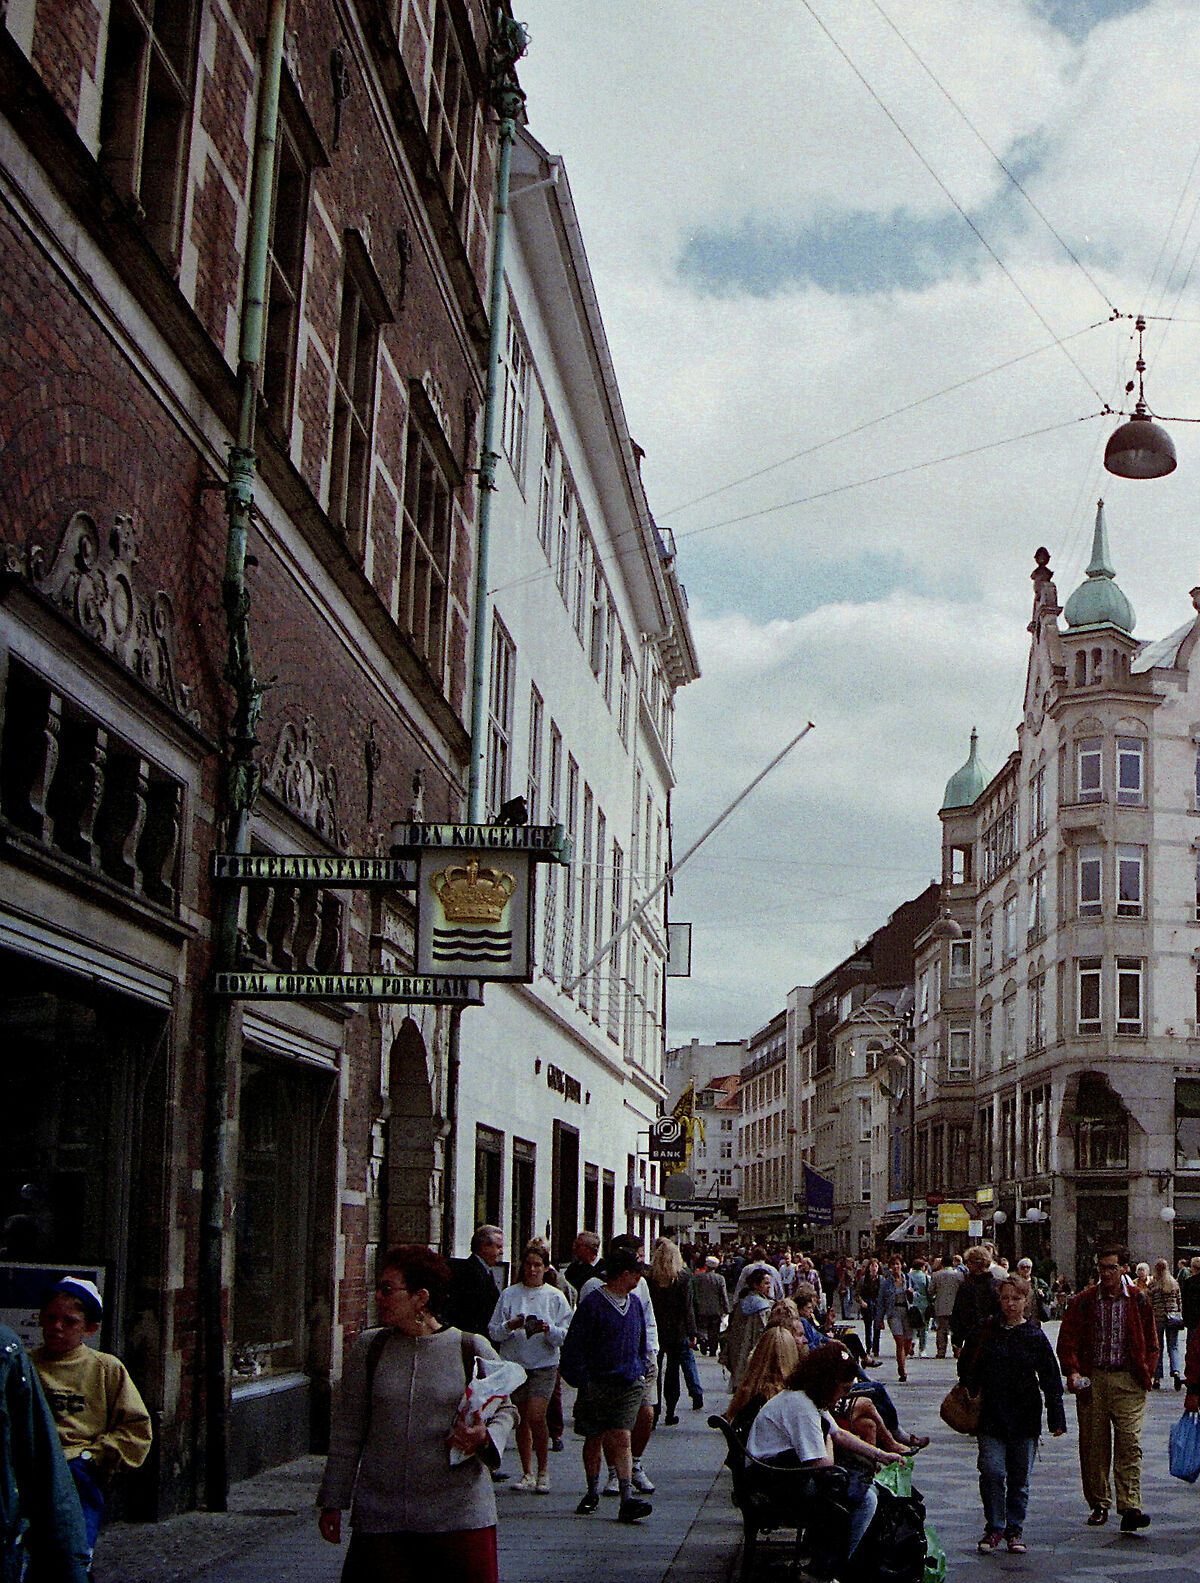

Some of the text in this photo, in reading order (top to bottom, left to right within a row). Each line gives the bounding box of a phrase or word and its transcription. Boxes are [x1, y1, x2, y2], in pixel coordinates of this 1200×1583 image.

[409, 825, 553, 848] DEN KONGELIGE
[216, 856, 406, 881] PORCELAINSFABRIK
[218, 974, 469, 998] ROYAL COPENHAGEN PORCELAIN
[653, 1151, 681, 1159] BANK
